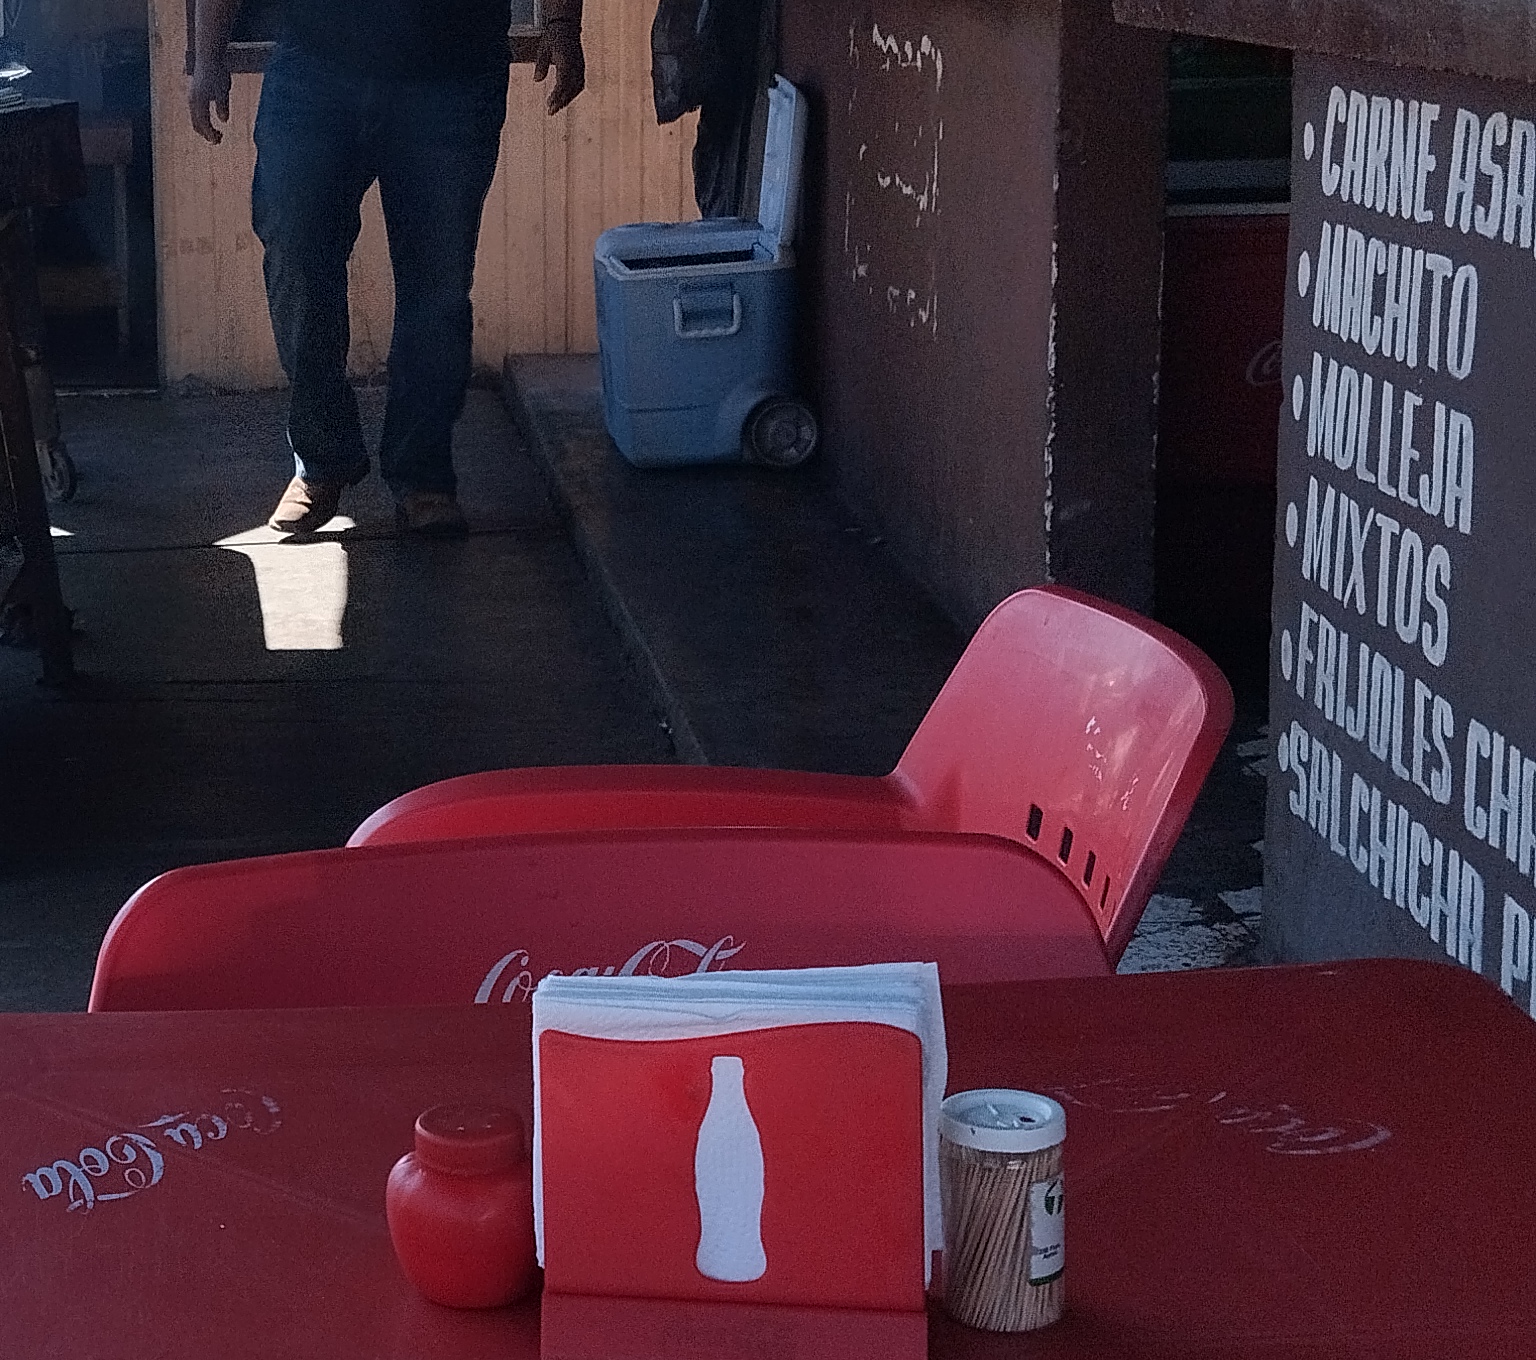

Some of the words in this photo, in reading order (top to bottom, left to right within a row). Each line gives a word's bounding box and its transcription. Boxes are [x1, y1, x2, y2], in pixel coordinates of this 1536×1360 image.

[1321, 85, 1441, 223] CARNE
[1444, 107, 1536, 260] ASA
[1312, 220, 1479, 380] MACHITO
[1306, 351, 1475, 535] MOLLEJA
[1301, 475, 1451, 667] MIXTOS
[1295, 600, 1455, 805] FRIJOLES
[1289, 720, 1485, 975] SALCHICHA
